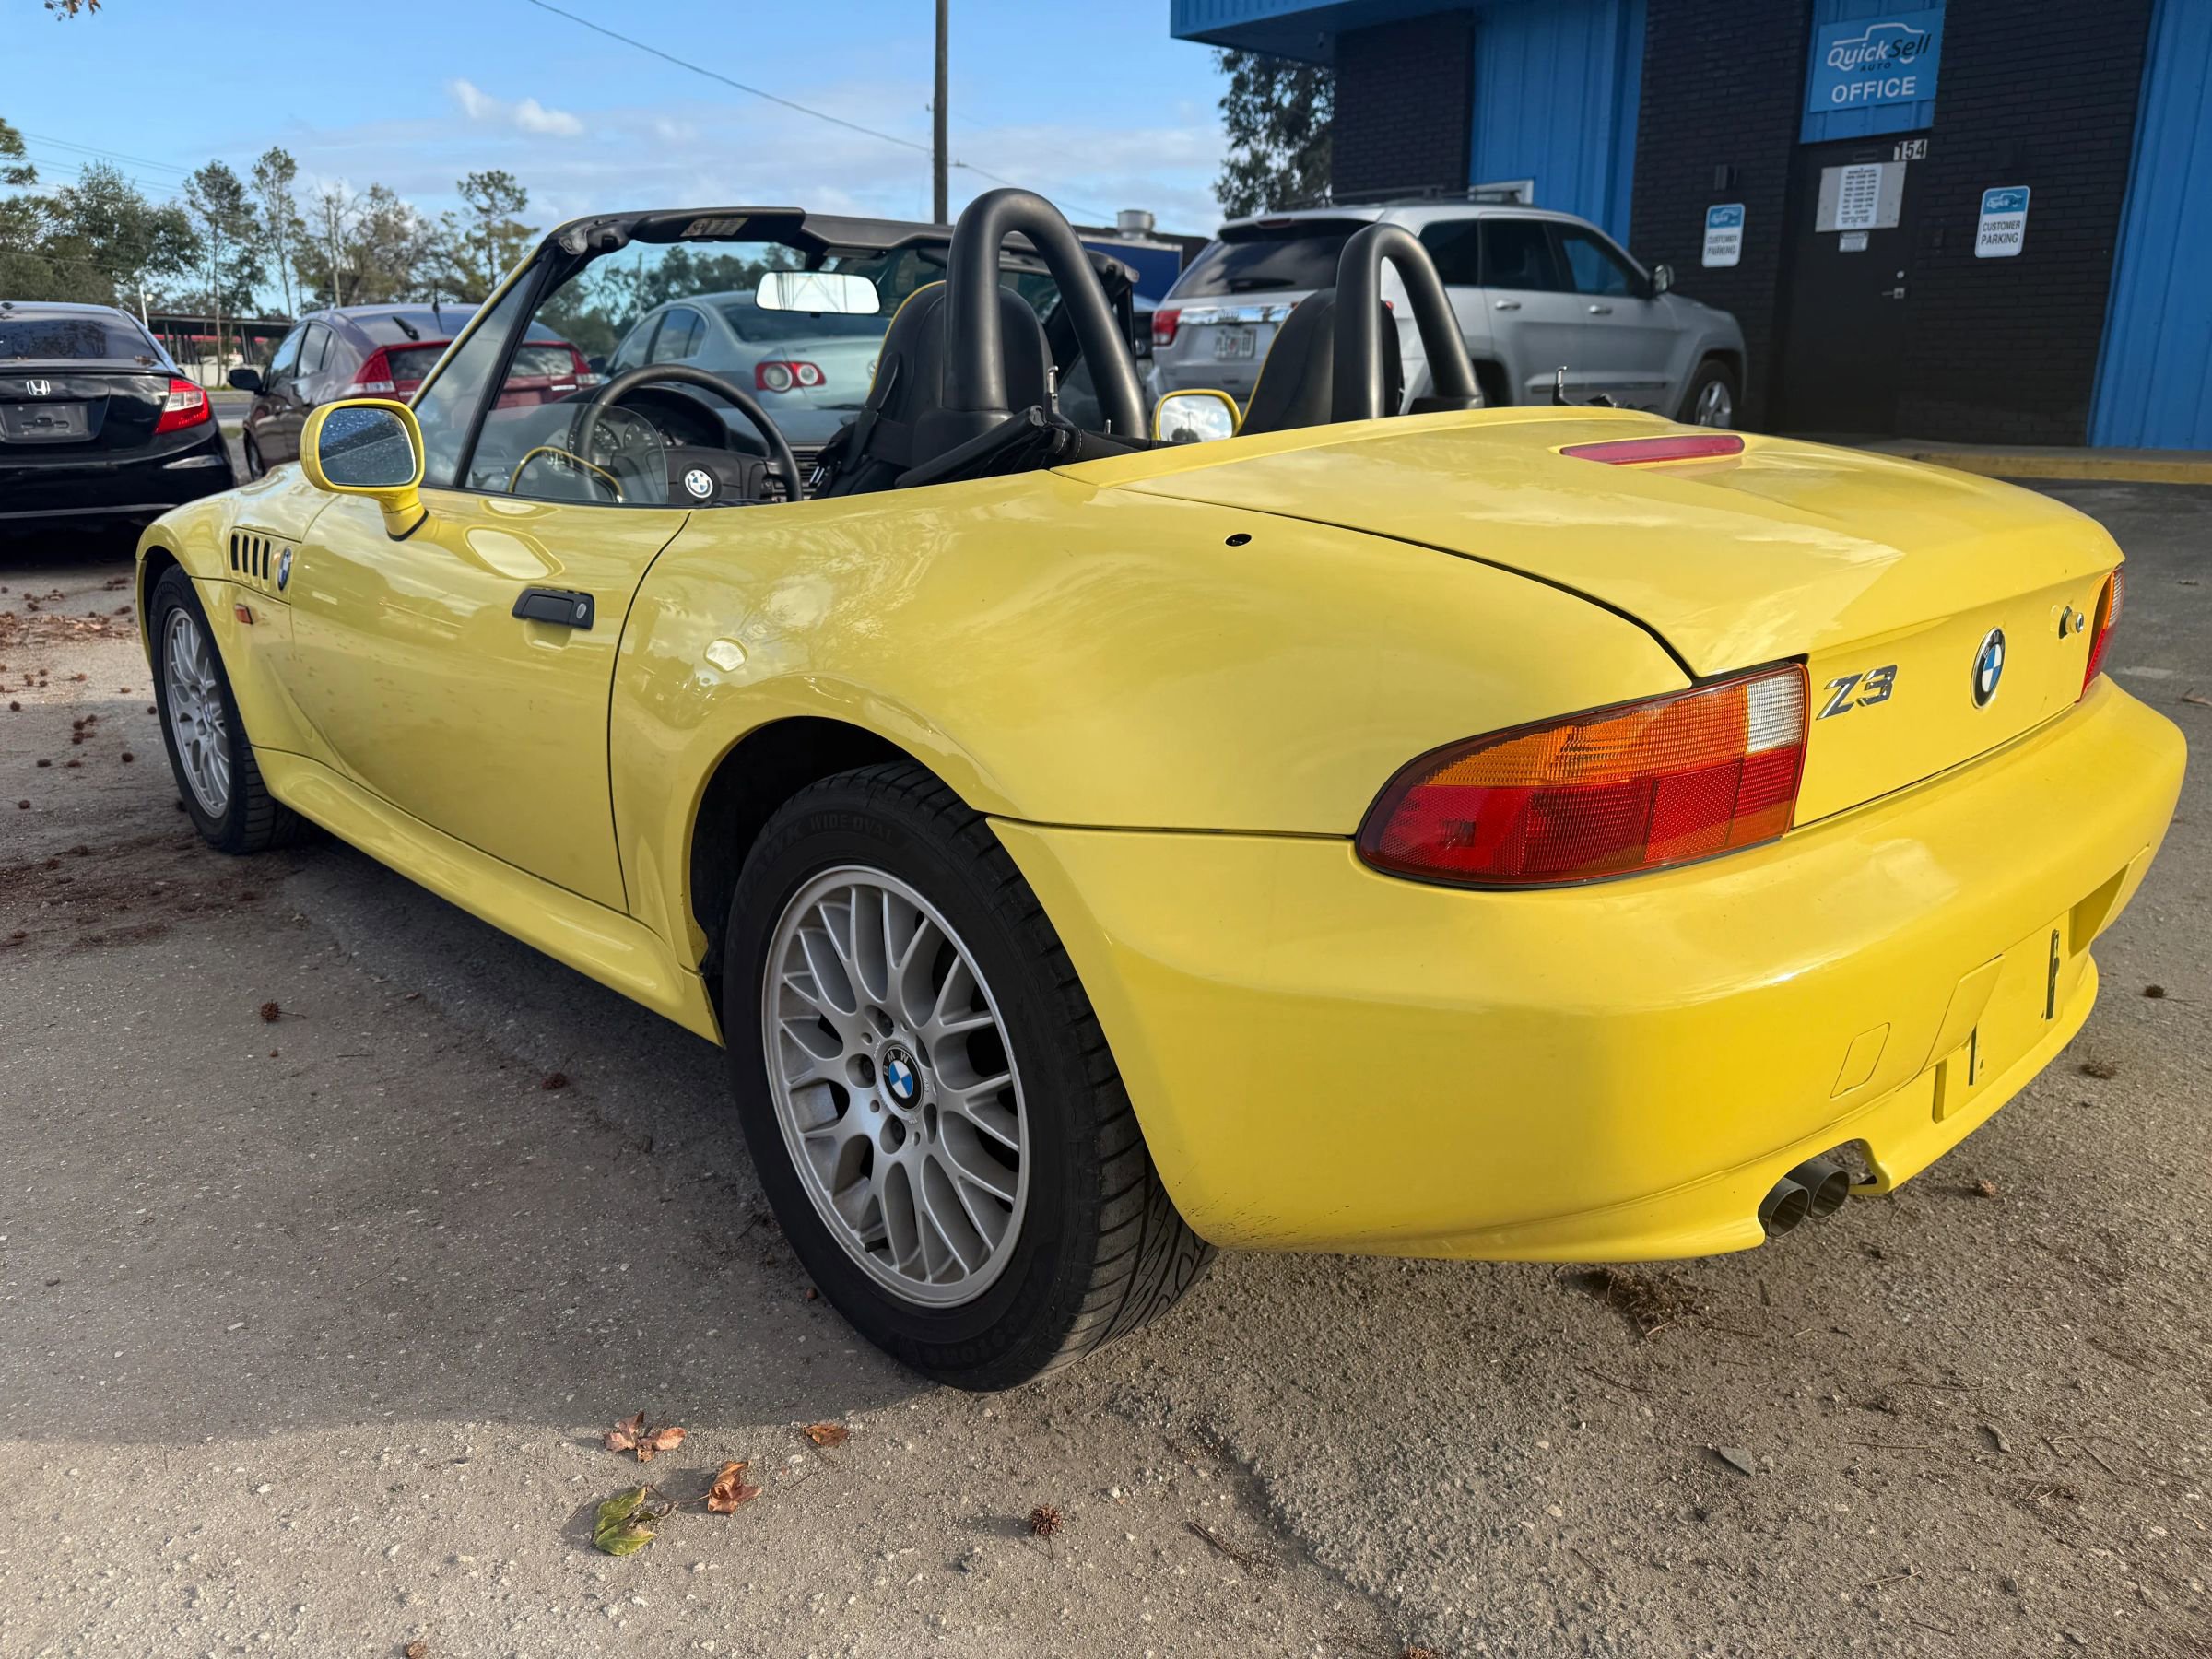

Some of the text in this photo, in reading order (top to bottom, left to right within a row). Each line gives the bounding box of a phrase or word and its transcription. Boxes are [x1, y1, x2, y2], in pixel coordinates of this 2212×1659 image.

[1860, 61, 1892, 72] AUTO
[1831, 76, 1917, 103] OFFICE
[1899, 139, 1925, 160] 154
[1983, 220, 2021, 232] CUSTOMER
[1980, 232, 2018, 245] PARKING
[1816, 665, 1897, 721] Z3
[810, 813, 892, 842] WIDE OVAL
